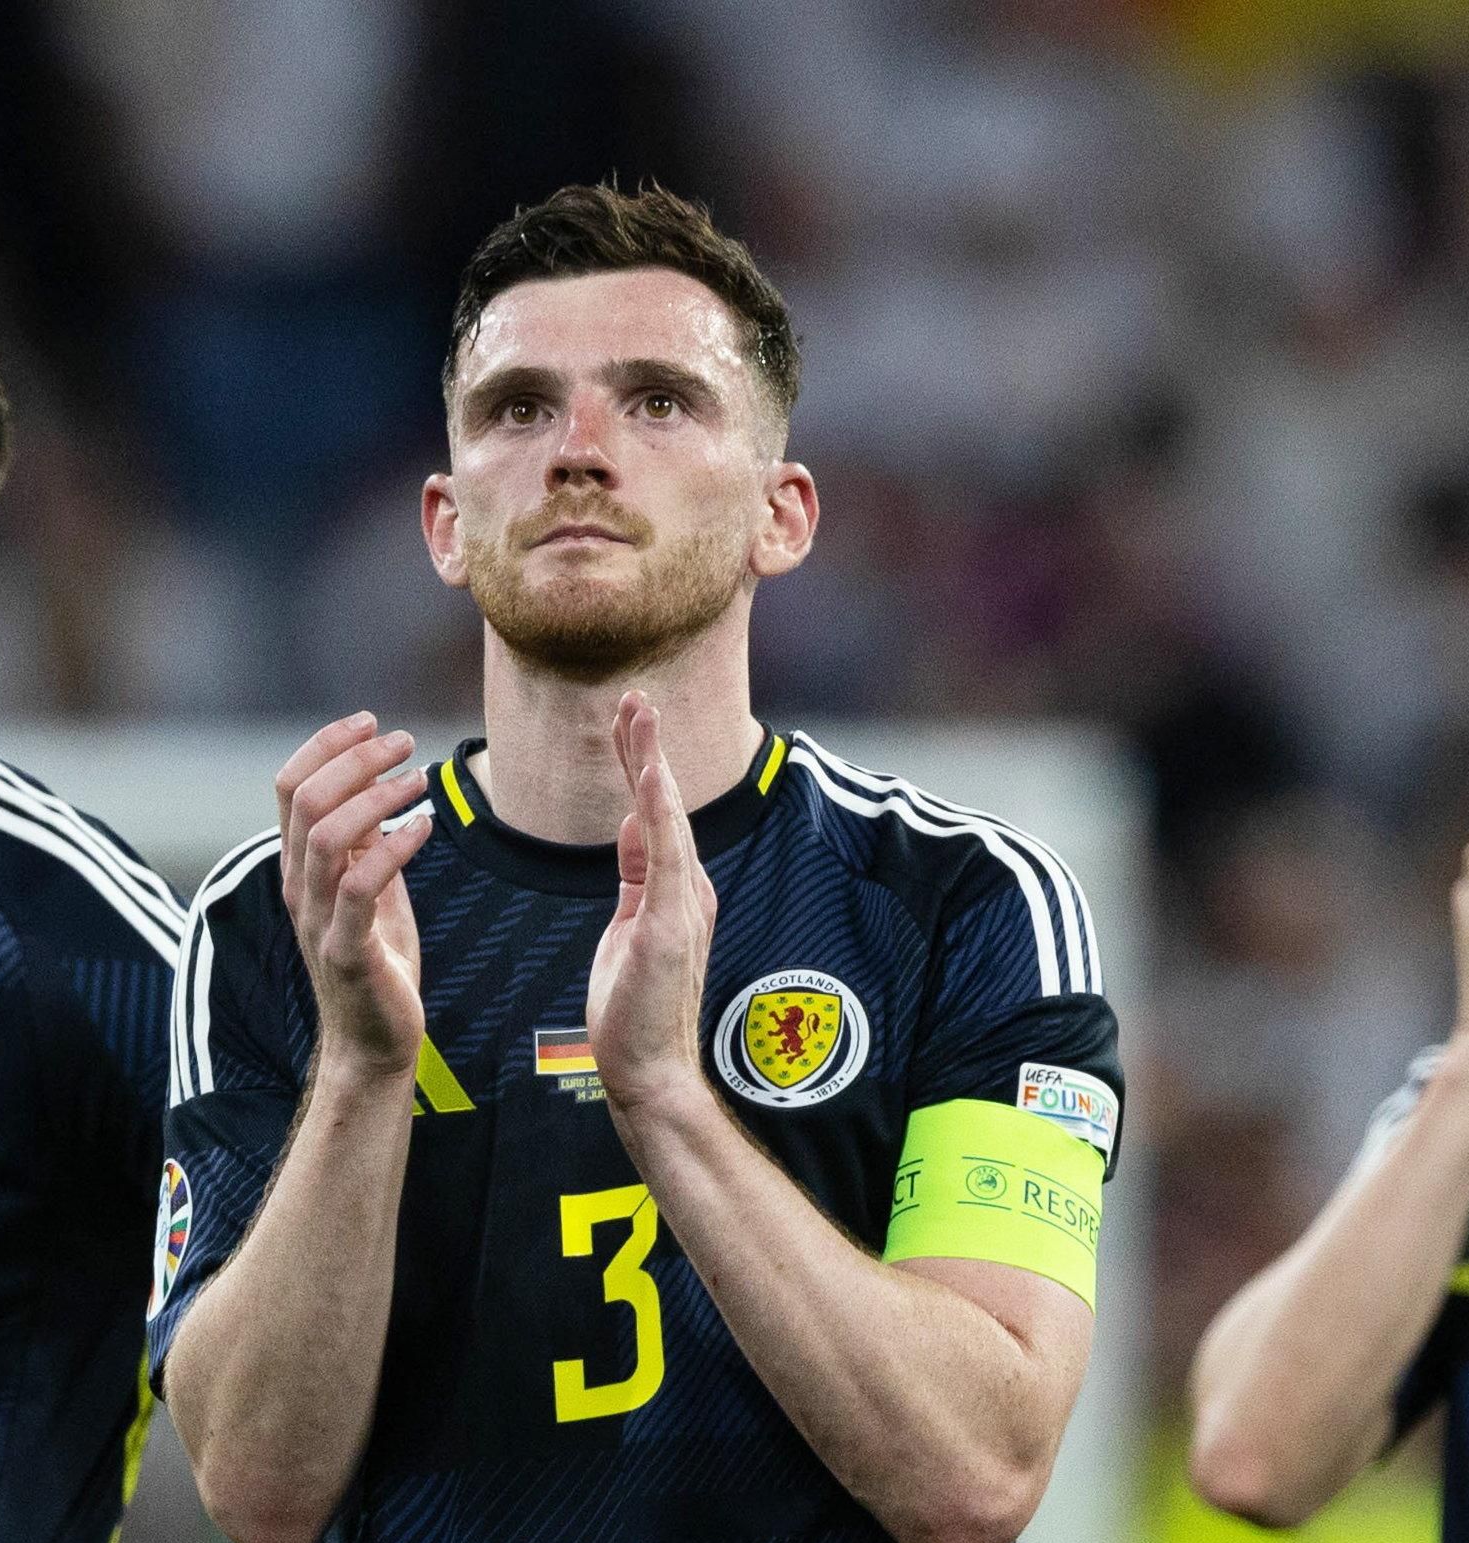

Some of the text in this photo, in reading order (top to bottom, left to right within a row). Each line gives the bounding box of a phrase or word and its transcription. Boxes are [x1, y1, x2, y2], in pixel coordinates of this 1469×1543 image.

[761, 974, 834, 992] SCOTLAND
[729, 1074, 749, 1092] EST
[1025, 1068, 1064, 1085] UEFA
[815, 1081, 841, 1099] 1873
[553, 1184, 665, 1423] 3
